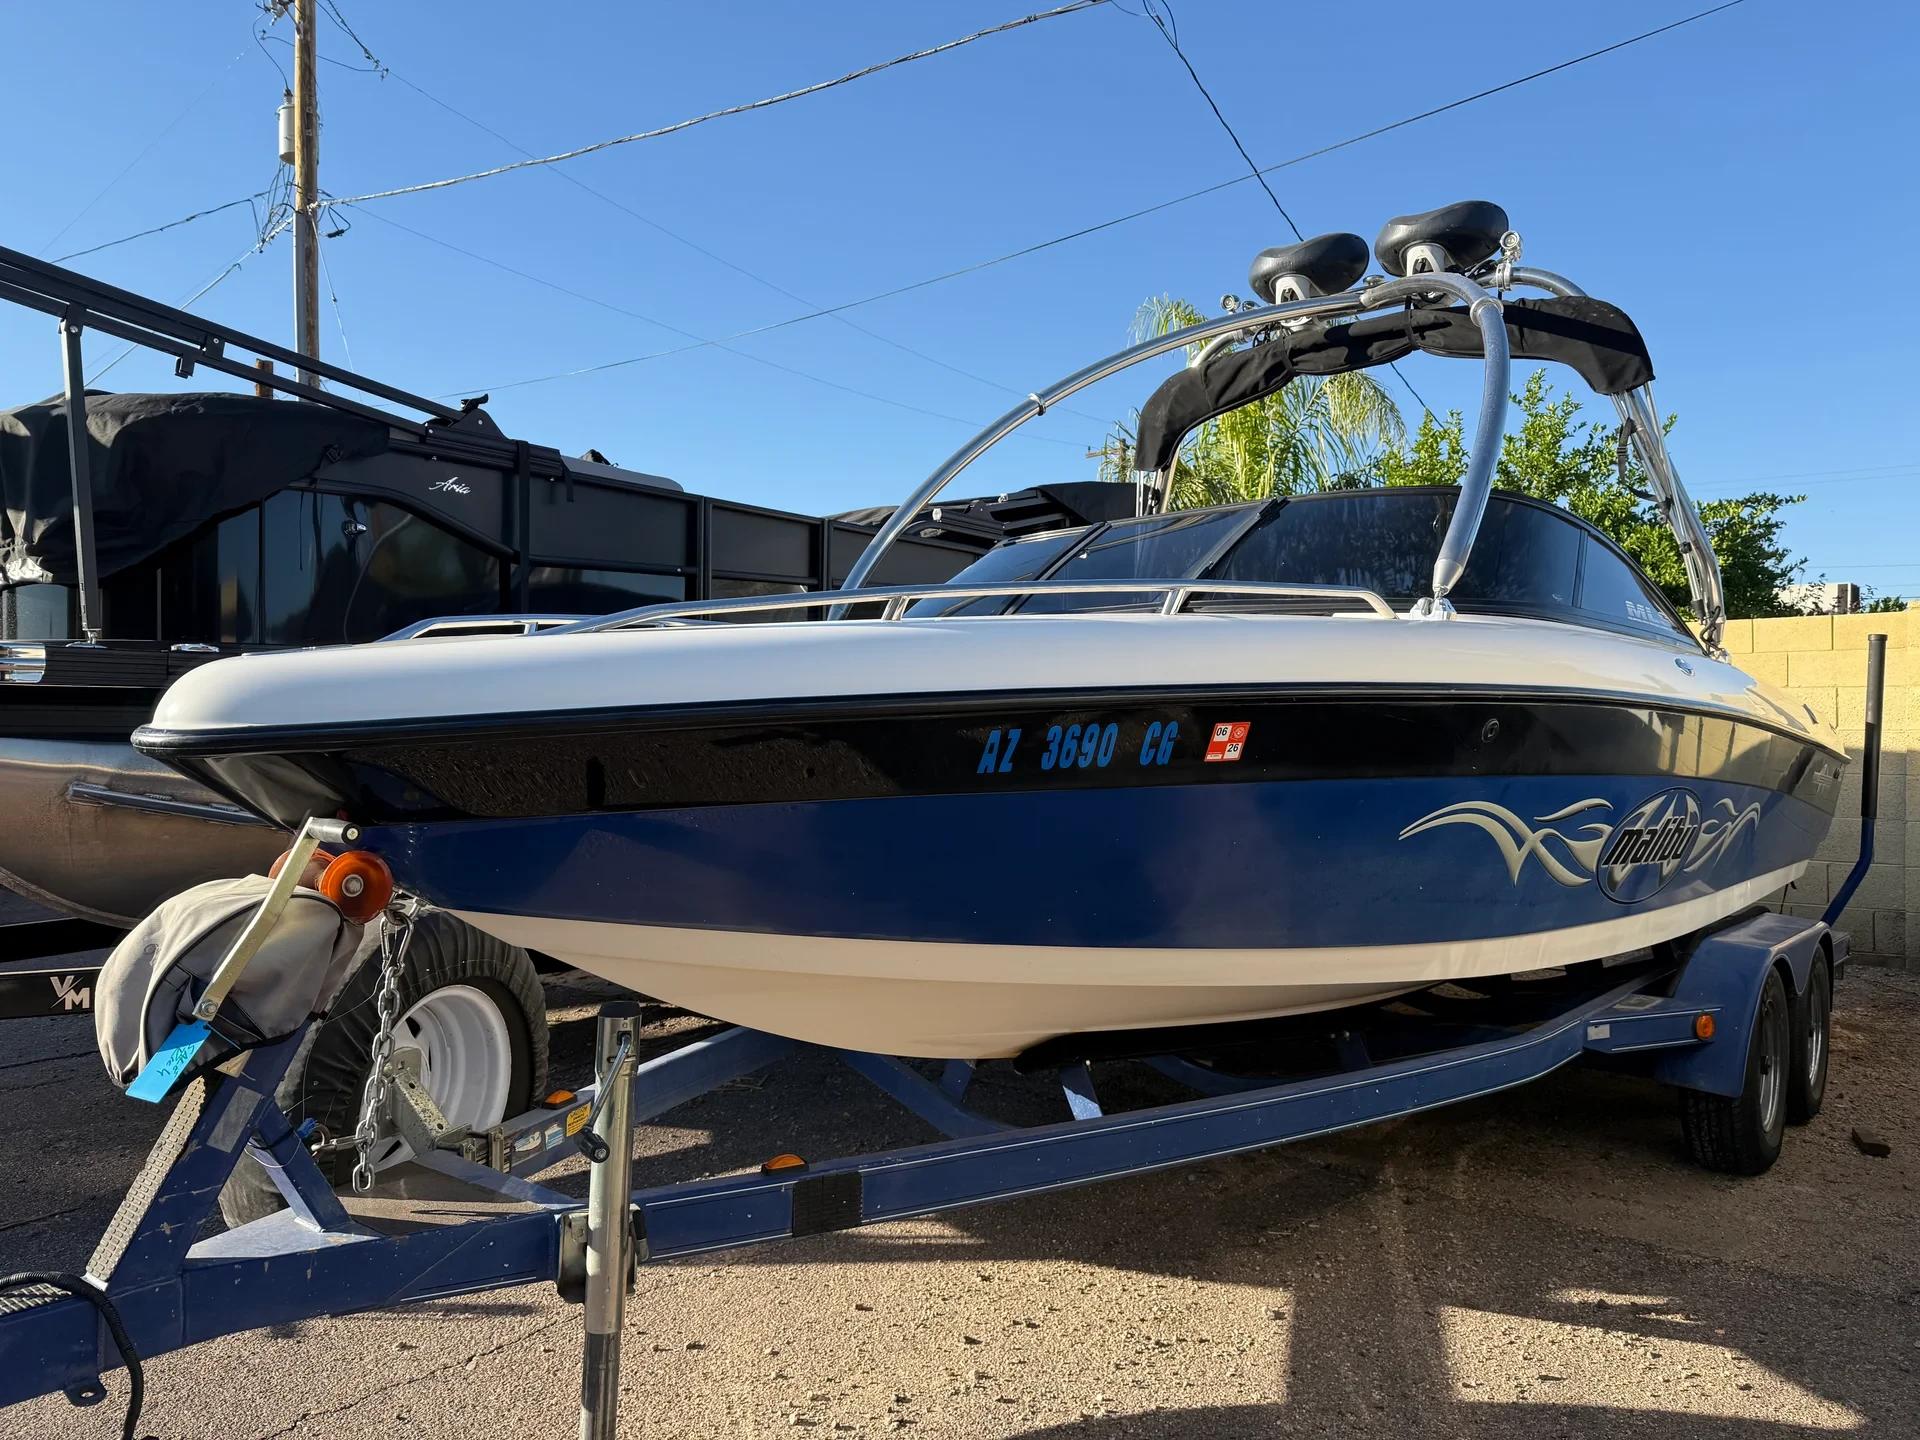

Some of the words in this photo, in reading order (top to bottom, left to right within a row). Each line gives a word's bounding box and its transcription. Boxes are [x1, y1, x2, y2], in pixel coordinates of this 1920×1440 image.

[428, 476, 471, 494] Aria
[1216, 727, 1228, 736] 06
[976, 728, 1022, 774] AZ
[1041, 722, 1119, 770] 3690
[1139, 721, 1179, 766] CG
[1227, 743, 1239, 752] 26
[1601, 816, 1698, 867] malibu
